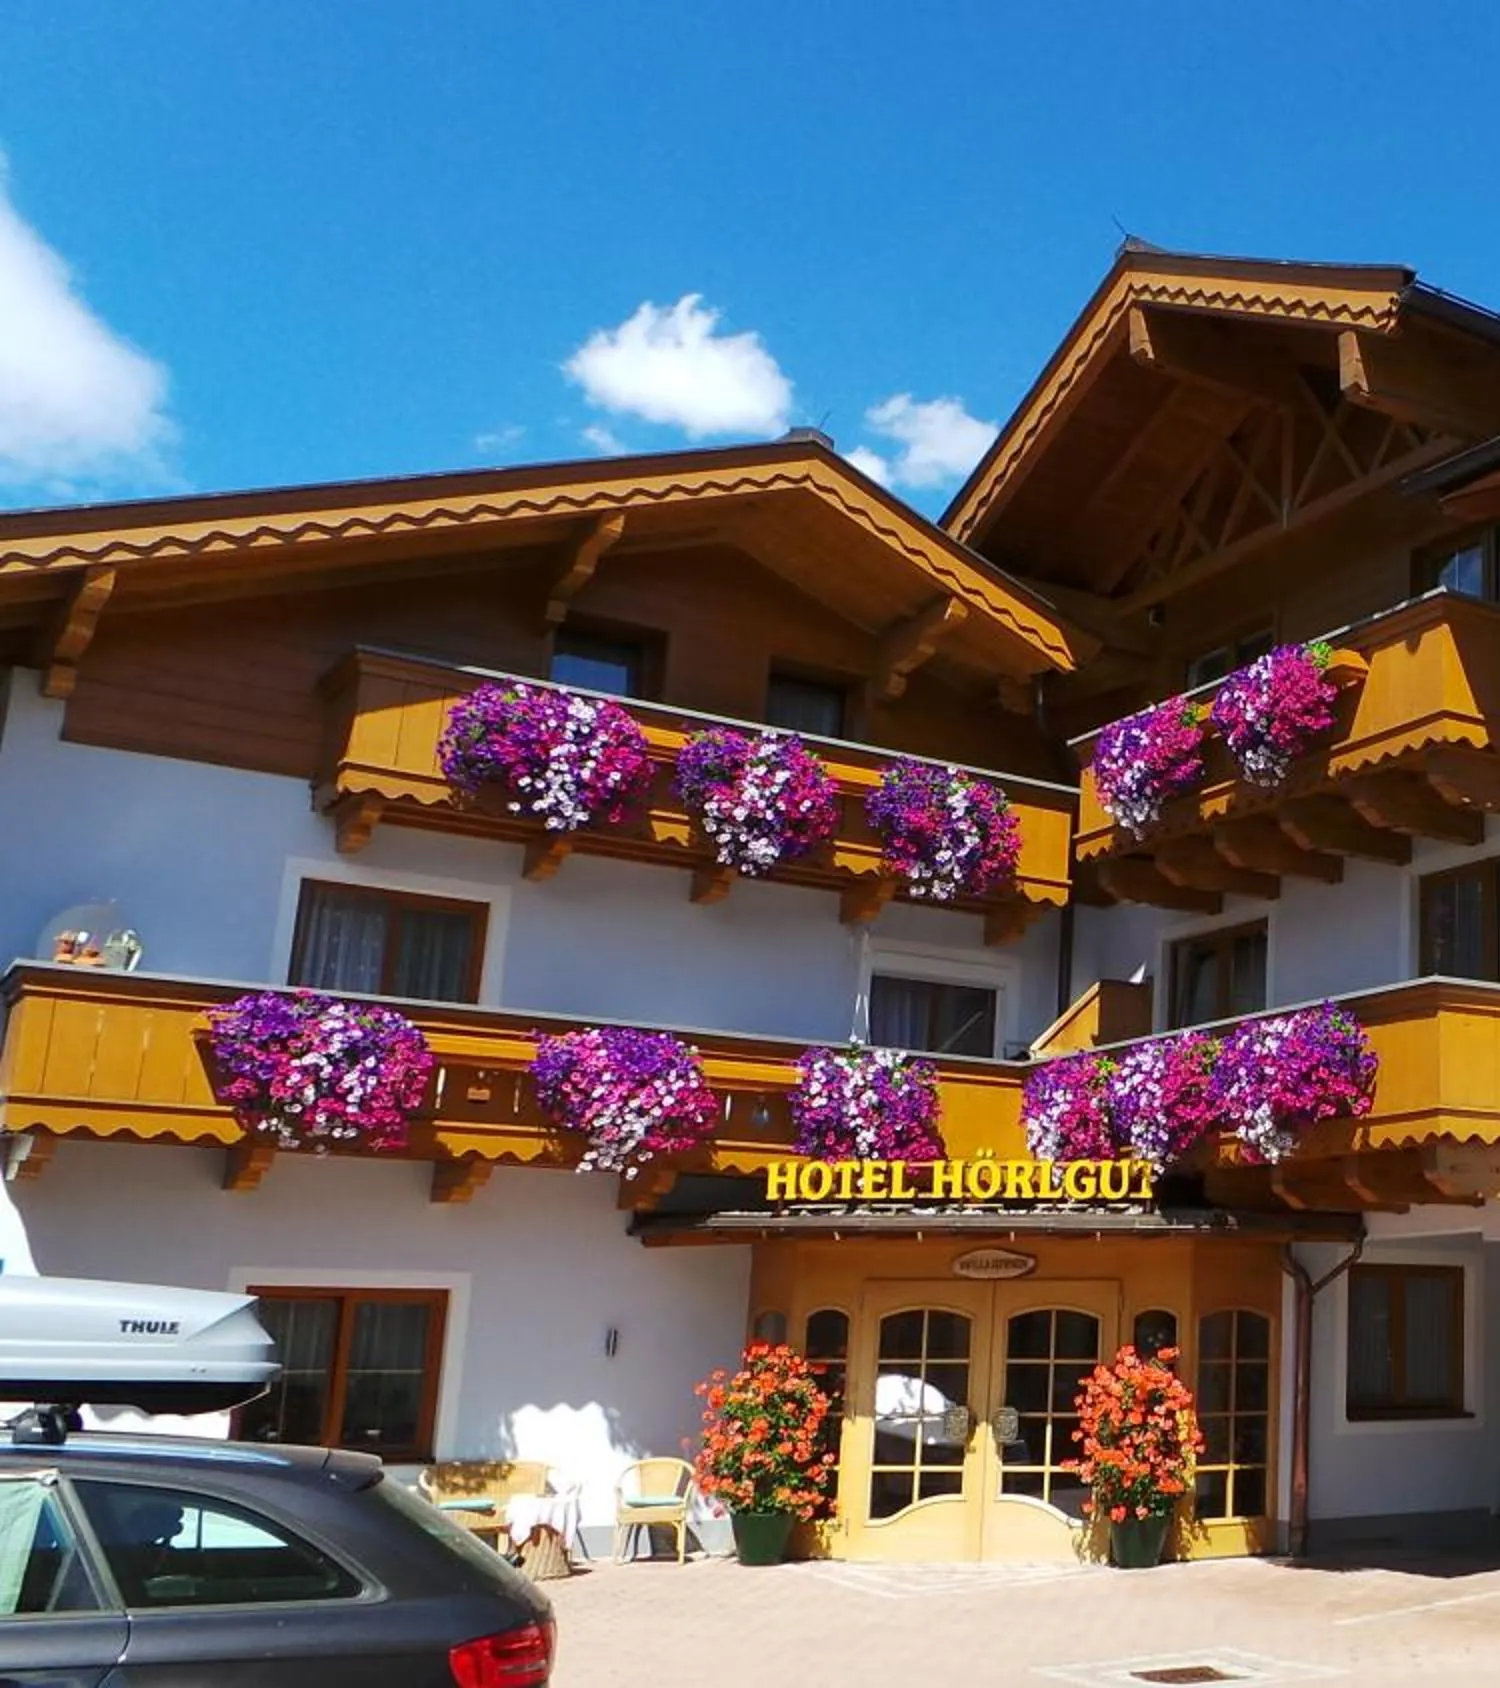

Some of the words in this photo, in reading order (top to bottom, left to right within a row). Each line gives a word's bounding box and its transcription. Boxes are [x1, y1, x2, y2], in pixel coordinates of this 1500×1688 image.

[766, 1160, 918, 1201] HOTEL
[932, 1147, 1153, 1201] HÖRLGUT
[120, 1319, 179, 1335] THULE
